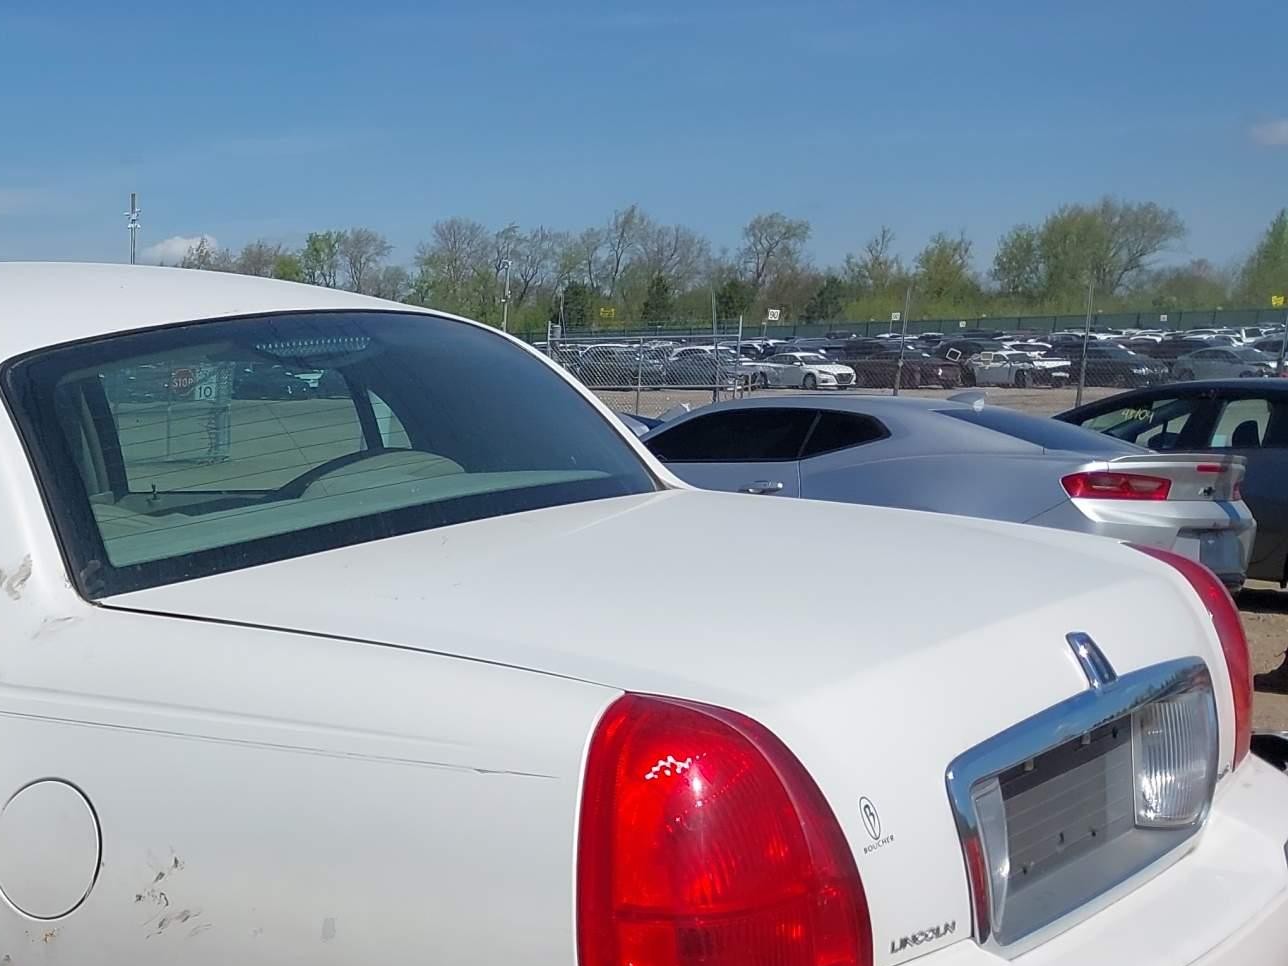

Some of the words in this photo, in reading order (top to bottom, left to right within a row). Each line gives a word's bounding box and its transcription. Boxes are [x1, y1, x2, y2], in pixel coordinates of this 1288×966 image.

[198, 386, 212, 398] 10
[863, 834, 895, 855] BOUCHER
[890, 920, 957, 954] LINCOLN
